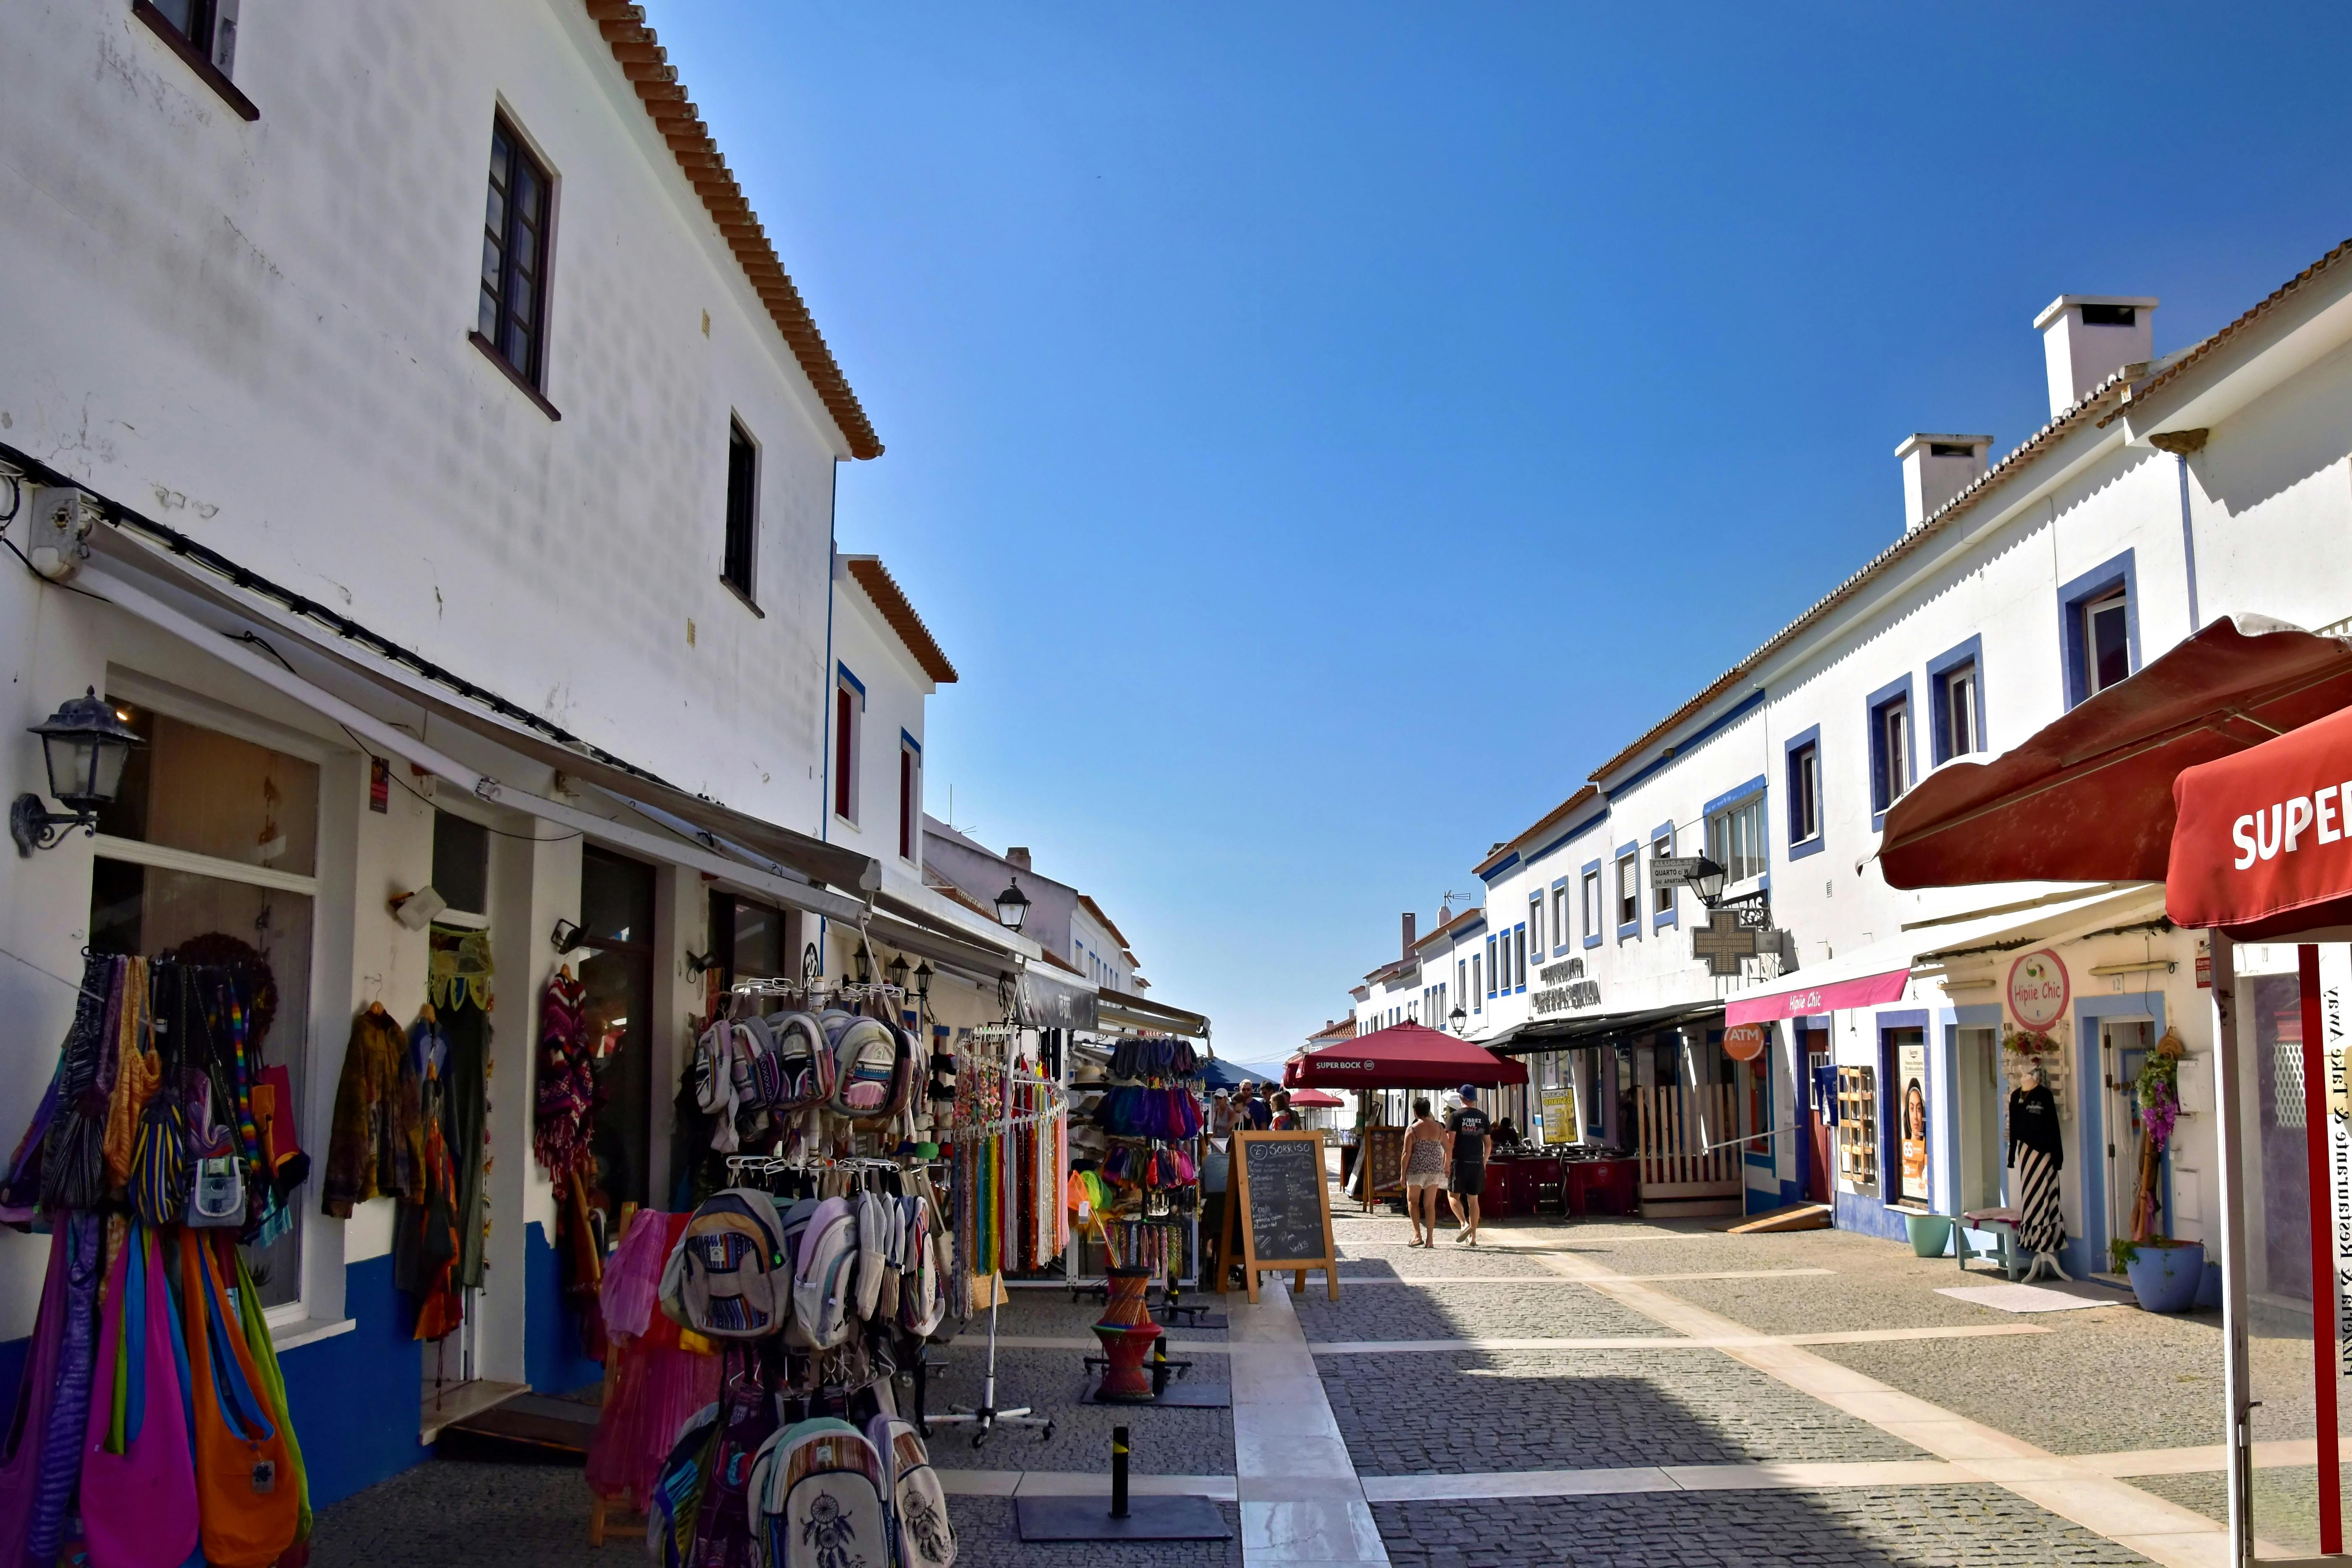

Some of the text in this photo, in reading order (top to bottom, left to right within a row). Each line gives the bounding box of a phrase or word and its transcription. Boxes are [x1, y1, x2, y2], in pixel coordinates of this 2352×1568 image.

[2113, 978, 2121, 991] 12
[1807, 991, 1821, 1007] Chic
[2014, 981, 2061, 1007] Hipiie Chic
[1729, 1029, 1759, 1041] ATM
[1543, 1097, 1572, 1107] QUARTO
[1269, 1142, 1310, 1155] SORRISO
[1903, 1141, 1913, 1157] 65
